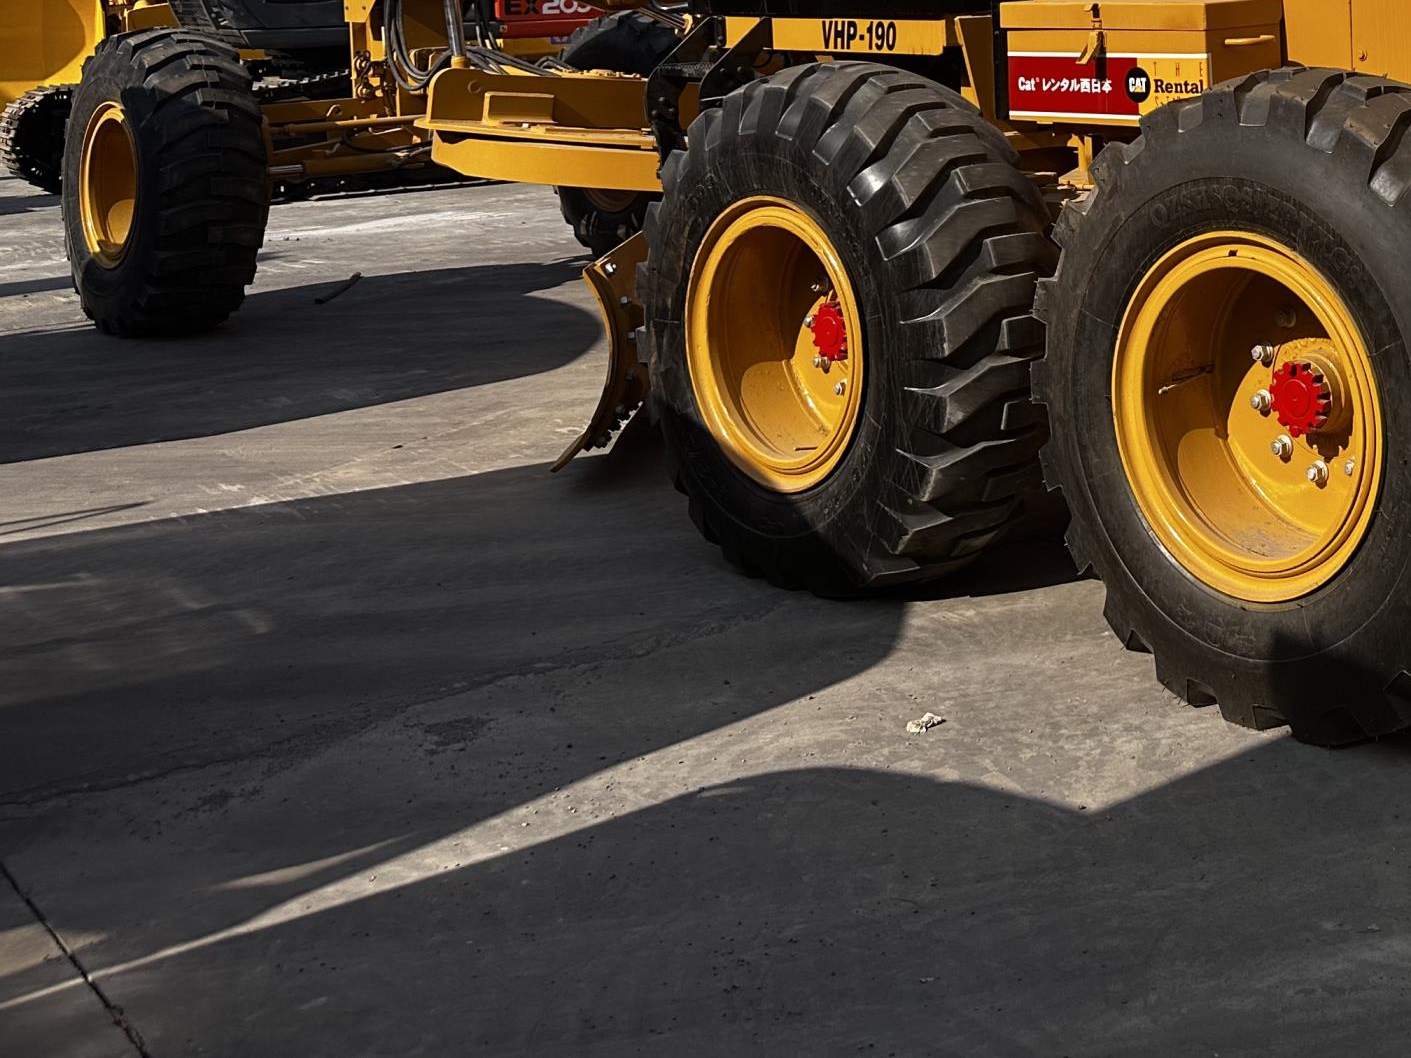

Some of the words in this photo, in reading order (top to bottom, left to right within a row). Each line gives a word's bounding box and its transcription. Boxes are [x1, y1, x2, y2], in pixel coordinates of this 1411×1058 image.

[821, 20, 897, 51] VHP-190
[1042, 78, 1112, 93] レンタル西日本
[1128, 77, 1147, 92] CAT
[1153, 78, 1203, 94] Rental
